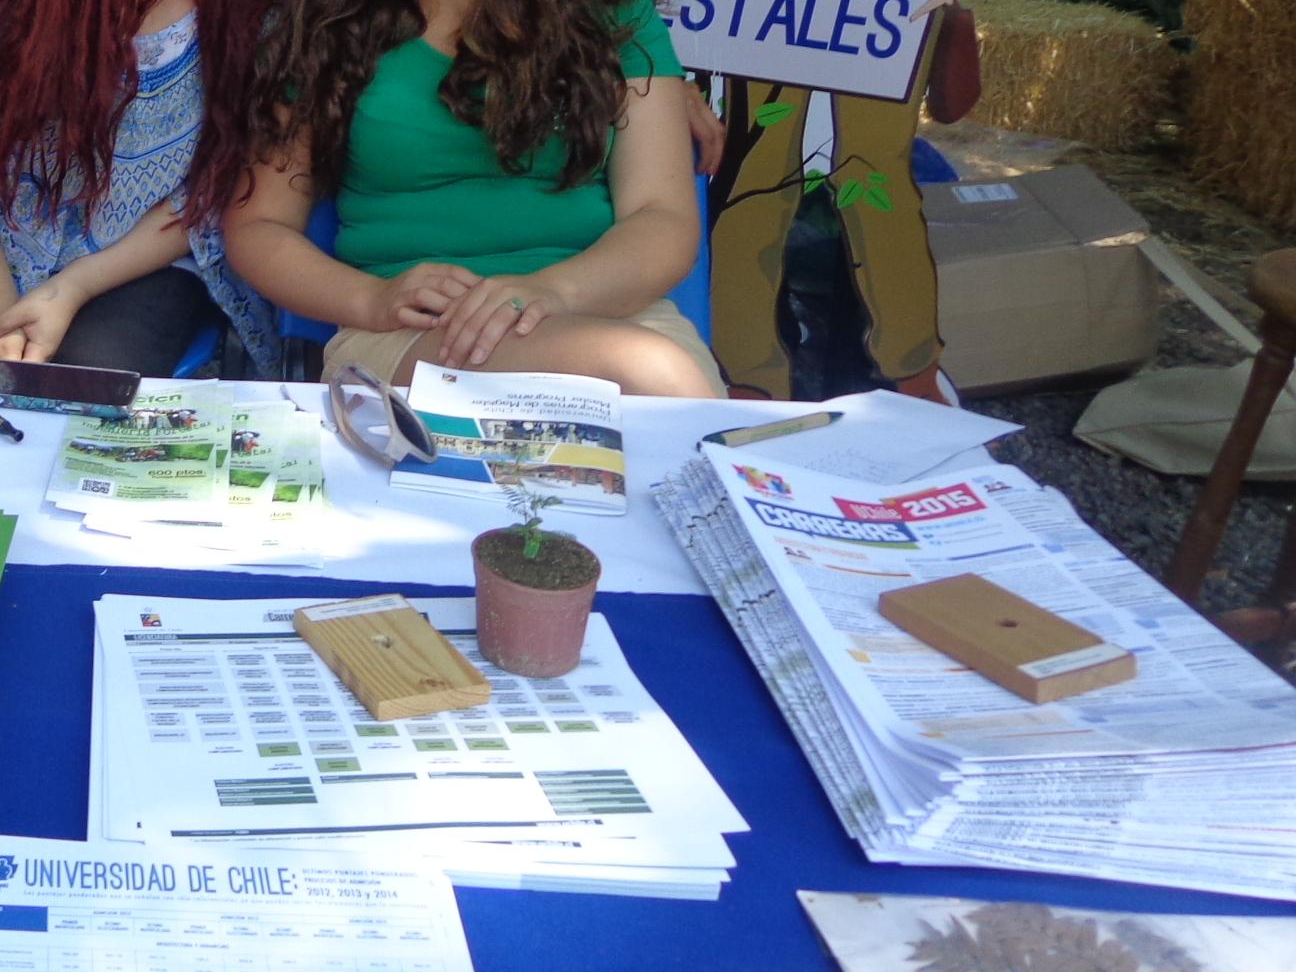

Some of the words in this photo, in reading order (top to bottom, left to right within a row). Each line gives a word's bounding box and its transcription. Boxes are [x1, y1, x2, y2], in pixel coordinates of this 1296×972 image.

[147, 469, 172, 477] 600
[902, 489, 978, 517] 2015
[760, 503, 911, 543] CARRERAS
[24, 857, 177, 892] UNIVERSIDAD
[187, 864, 217, 894] DE
[227, 865, 299, 896] CHILE:
[337, 887, 362, 898] 2013
[365, 890, 372, 900] y
[374, 889, 399, 899] 2014
